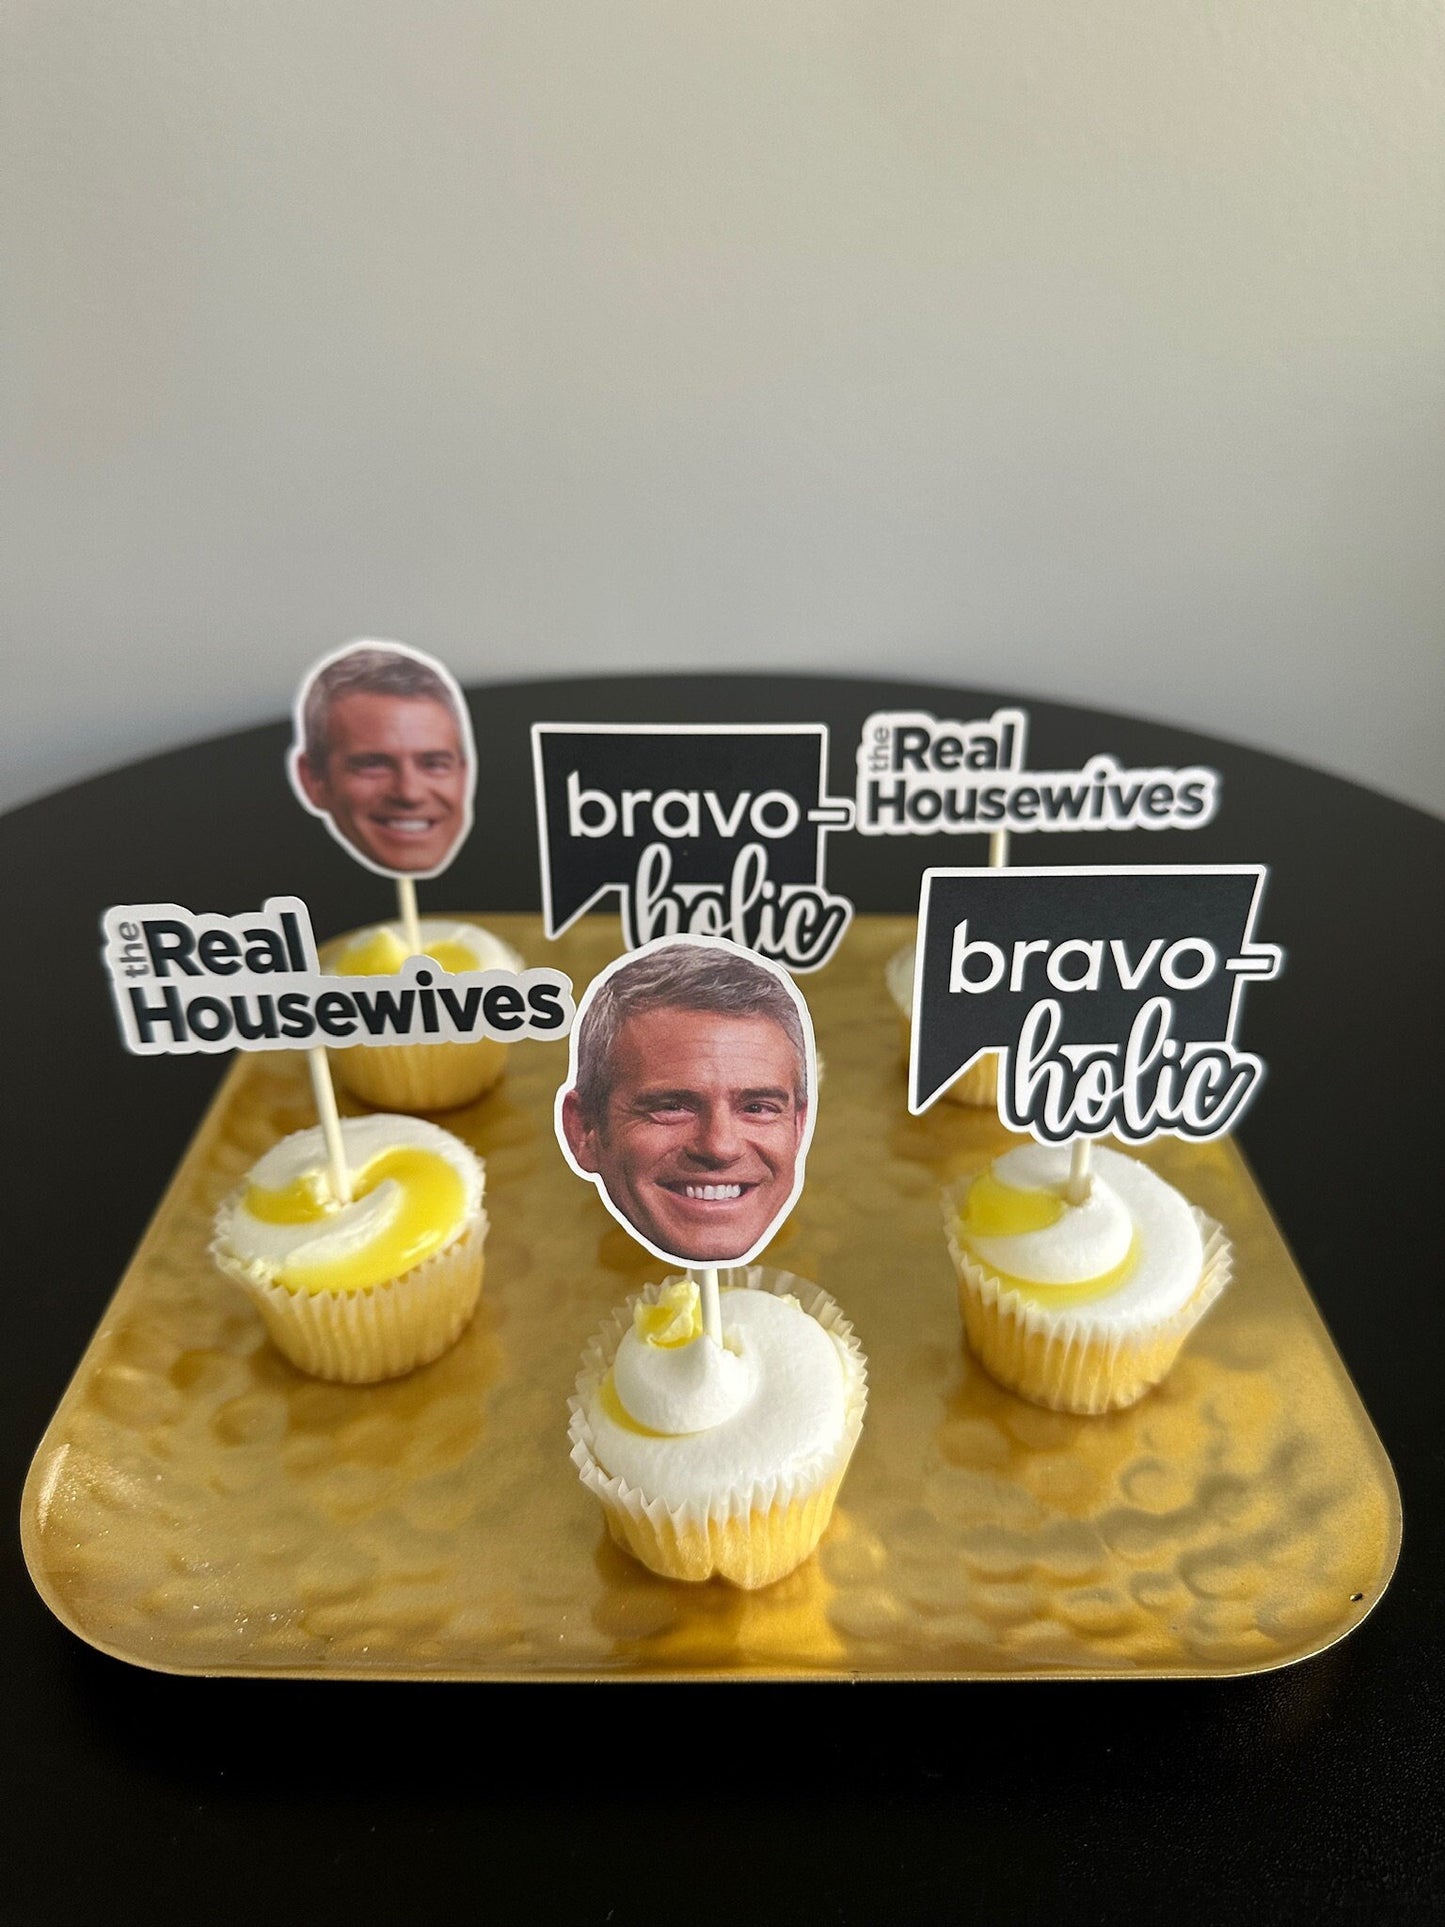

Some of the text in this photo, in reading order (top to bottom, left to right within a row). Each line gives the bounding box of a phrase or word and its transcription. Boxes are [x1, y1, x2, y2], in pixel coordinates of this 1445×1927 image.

[866, 726, 890, 773] the
[891, 723, 1015, 774] Real
[867, 769, 1206, 826] Housewives
[635, 842, 840, 957] holic
[118, 920, 148, 979] the
[142, 911, 308, 978] Real
[128, 969, 566, 1044] Housewives
[1013, 996, 1247, 1133] holic
